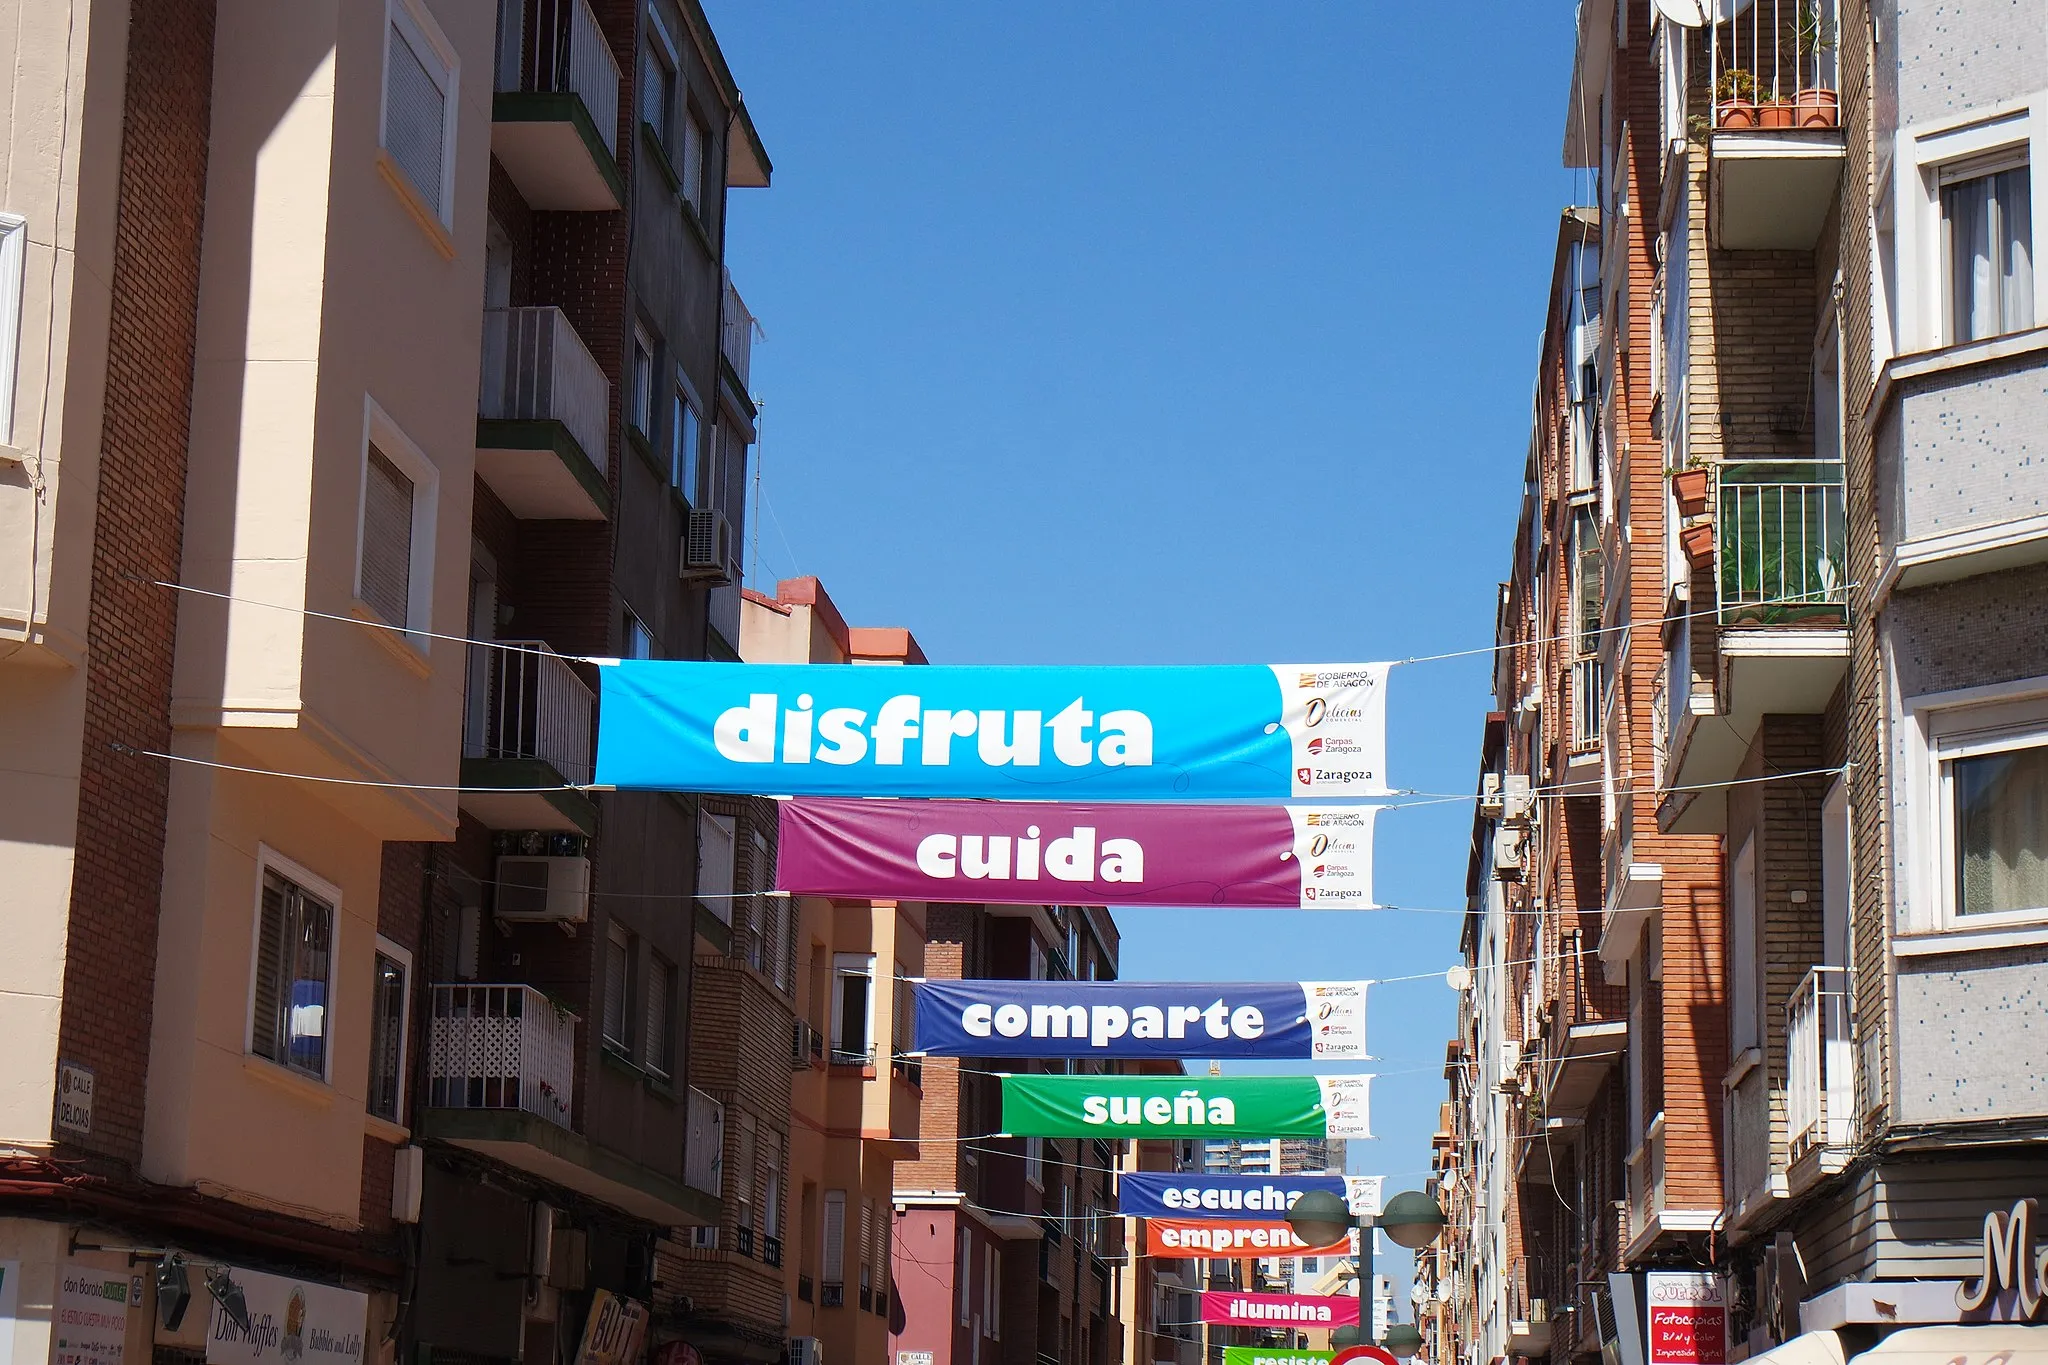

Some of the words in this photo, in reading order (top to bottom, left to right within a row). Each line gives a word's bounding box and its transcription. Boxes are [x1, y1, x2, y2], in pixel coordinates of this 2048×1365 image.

[1317, 671, 1368, 680] GOBIERNO
[1316, 681, 1330, 689] DE
[1305, 697, 1362, 728] Delicias
[713, 693, 1154, 767] disfruta
[1325, 737, 1353, 746] Carpas
[1325, 745, 1362, 755] Zaragoza
[1315, 769, 1372, 783] Zaragoza
[915, 824, 1144, 883] cuida
[1319, 888, 1362, 900] Zaragoza
[961, 998, 1265, 1047] comparte
[1325, 1043, 1359, 1052] Zaragoza
[73, 1076, 91, 1095] CALLE
[60, 1102, 90, 1129] DELICIAS
[1082, 1089, 1236, 1126] sueña
[1954, 1197, 2048, 1320] M
[1653, 1286, 1722, 1302] QUEROL
[1229, 1299, 1332, 1322] ilumina
[214, 1307, 238, 1342] Don
[1654, 1312, 1722, 1329] Fotocopias
[1662, 1332, 1683, 1341] B/N
[1655, 1348, 1696, 1358] Impresión
